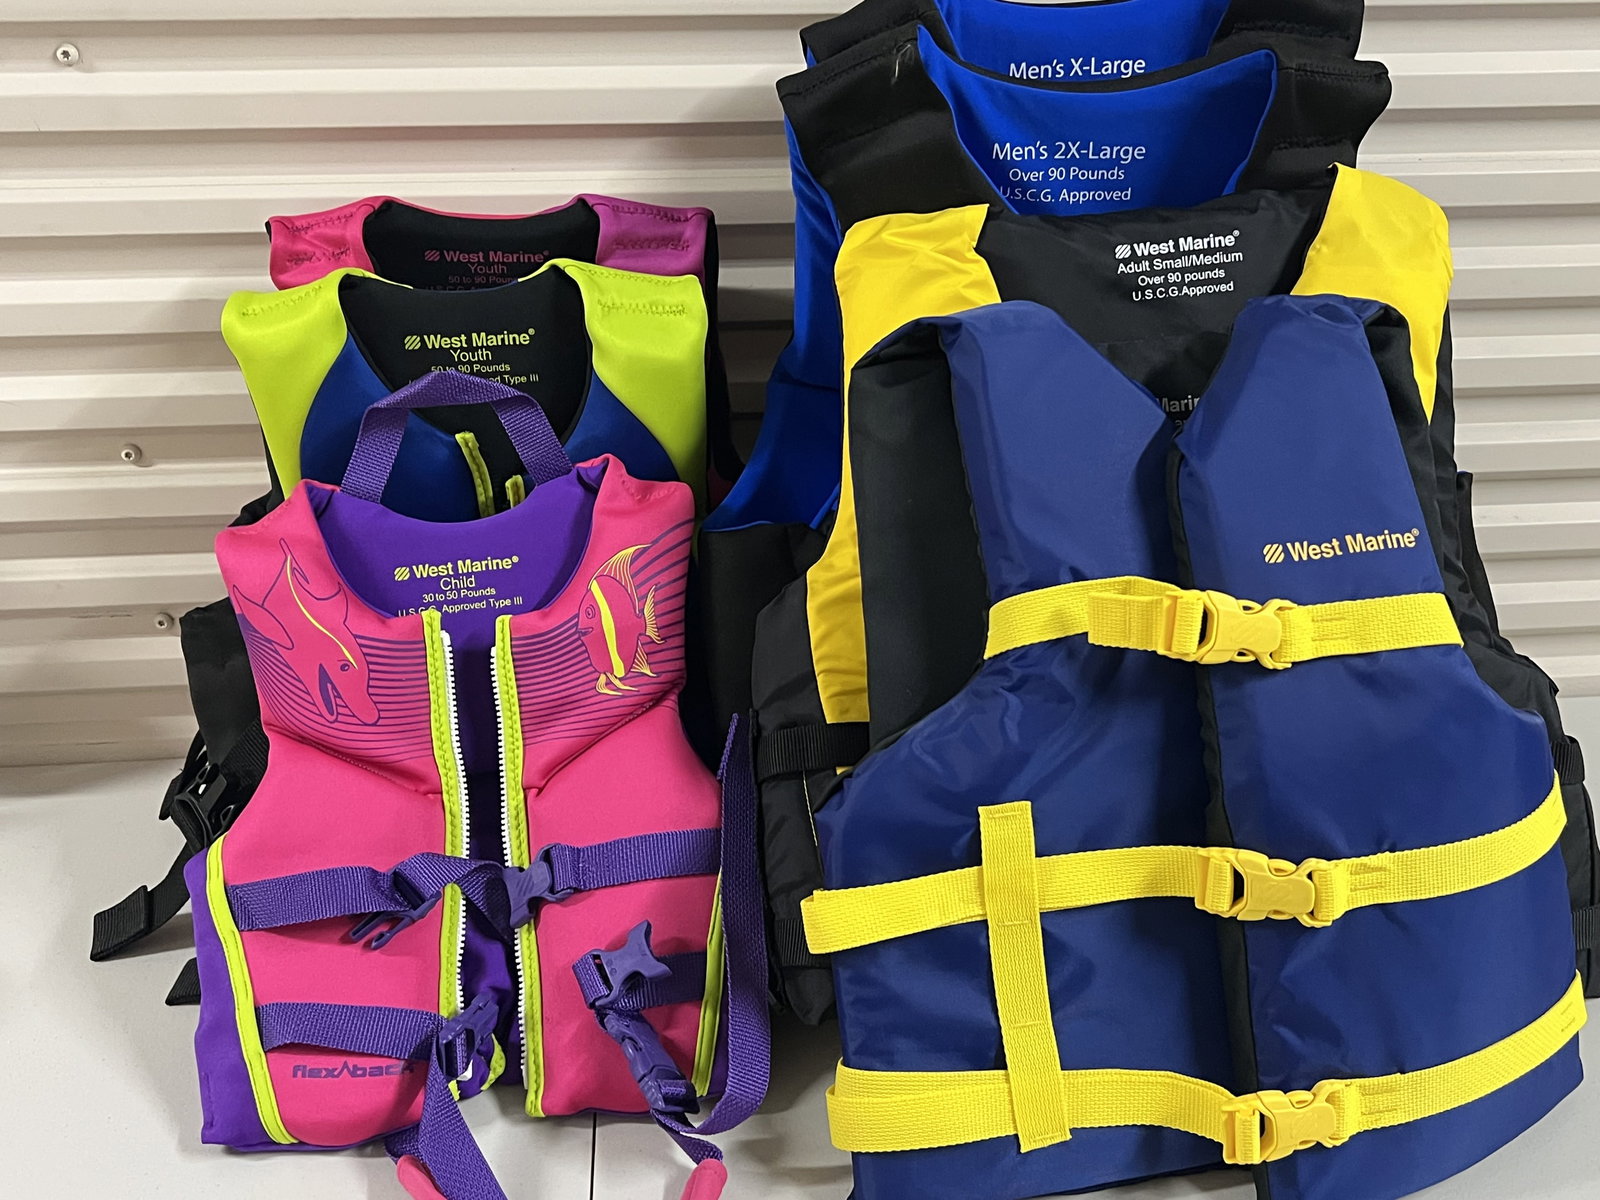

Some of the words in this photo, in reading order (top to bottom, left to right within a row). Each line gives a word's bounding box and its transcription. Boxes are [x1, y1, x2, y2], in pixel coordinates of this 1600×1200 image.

[1009, 59, 1064, 80] Men's
[1070, 57, 1146, 78] X-Large
[992, 140, 1048, 161] Men's
[1054, 141, 1146, 164] 2X-Large
[1009, 168, 1044, 182] Over
[1048, 167, 1066, 181] 90
[1070, 166, 1125, 180] Pounds
[1000, 186, 1055, 202] U.S.C.G.
[1059, 187, 1132, 205] Approved
[444, 250, 484, 262] West
[1133, 239, 1176, 257] West
[468, 263, 507, 274] Youth
[1117, 260, 1151, 274] Adult
[1153, 251, 1244, 270] Small/Medium
[462, 275, 472, 283] to
[1138, 274, 1165, 286] Over
[1167, 272, 1182, 283] 90
[1184, 268, 1225, 283] pounds
[423, 334, 468, 349] West
[450, 348, 492, 362] Youth
[458, 364, 470, 373] 90
[473, 363, 511, 373] Pounds
[503, 374, 527, 385] Type
[530, 373, 539, 382] III
[1286, 538, 1343, 562] West
[412, 562, 454, 579] West
[440, 575, 476, 591] Child
[422, 593, 434, 603] 30
[435, 593, 445, 601] to
[446, 591, 458, 600] 50
[461, 587, 496, 599] Pounds
[442, 600, 487, 613] Approved
[489, 598, 511, 610] Type
[514, 596, 523, 605] III
